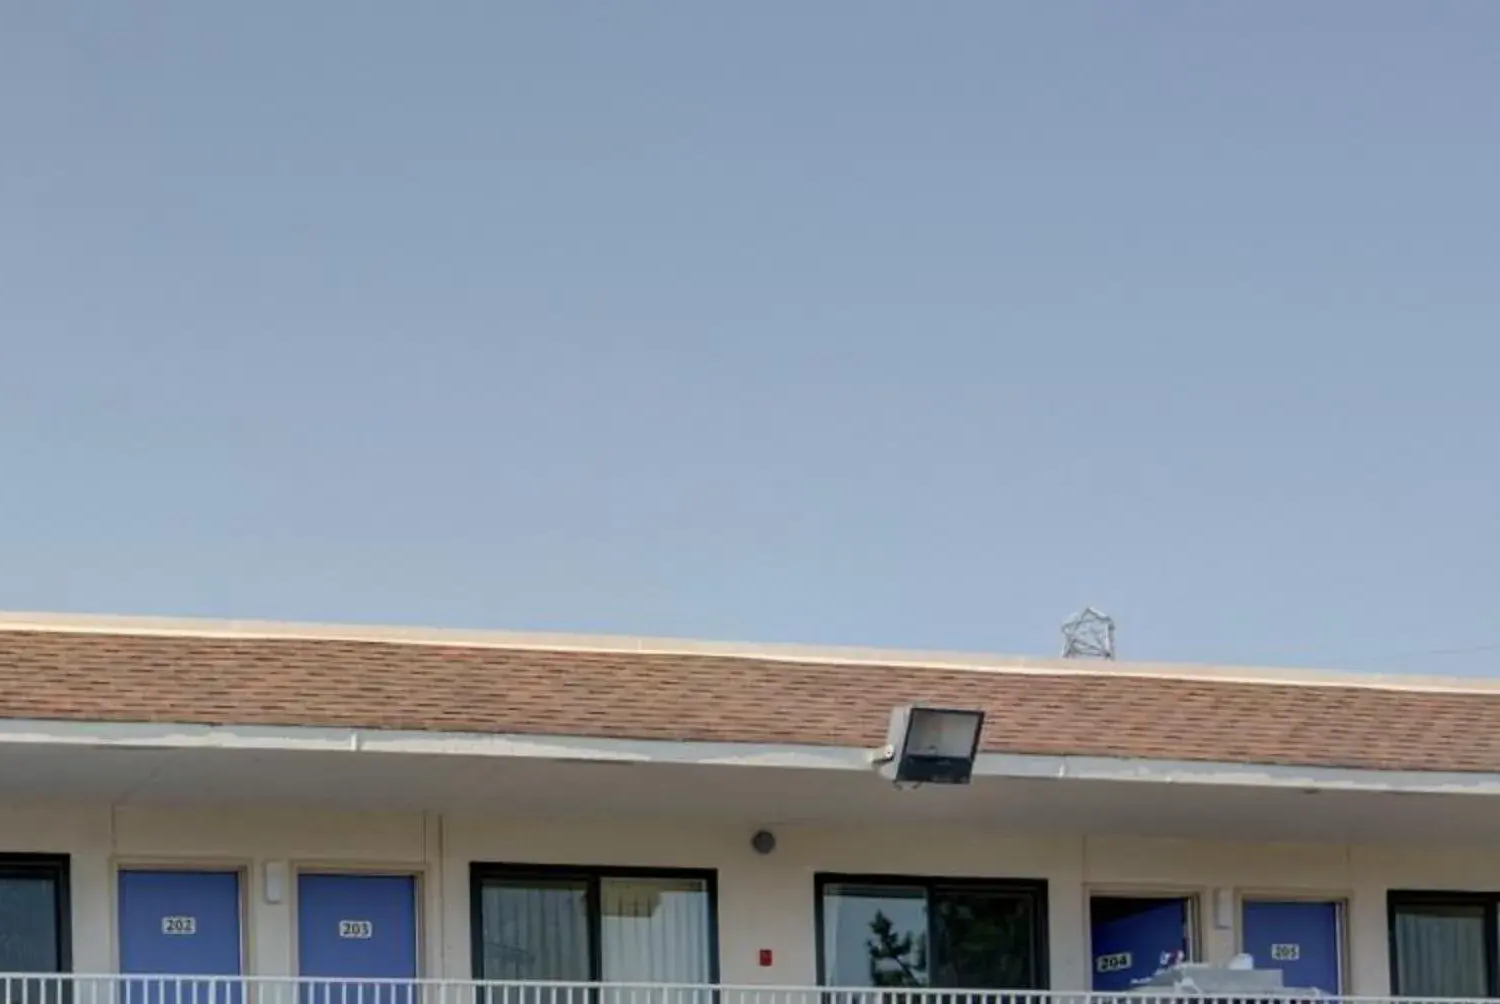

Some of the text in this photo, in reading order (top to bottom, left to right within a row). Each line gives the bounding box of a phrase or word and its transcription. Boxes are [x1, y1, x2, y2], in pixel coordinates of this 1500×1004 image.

[166, 918, 192, 931] 202
[341, 922, 369, 936] 203
[1100, 955, 1128, 970] 204
